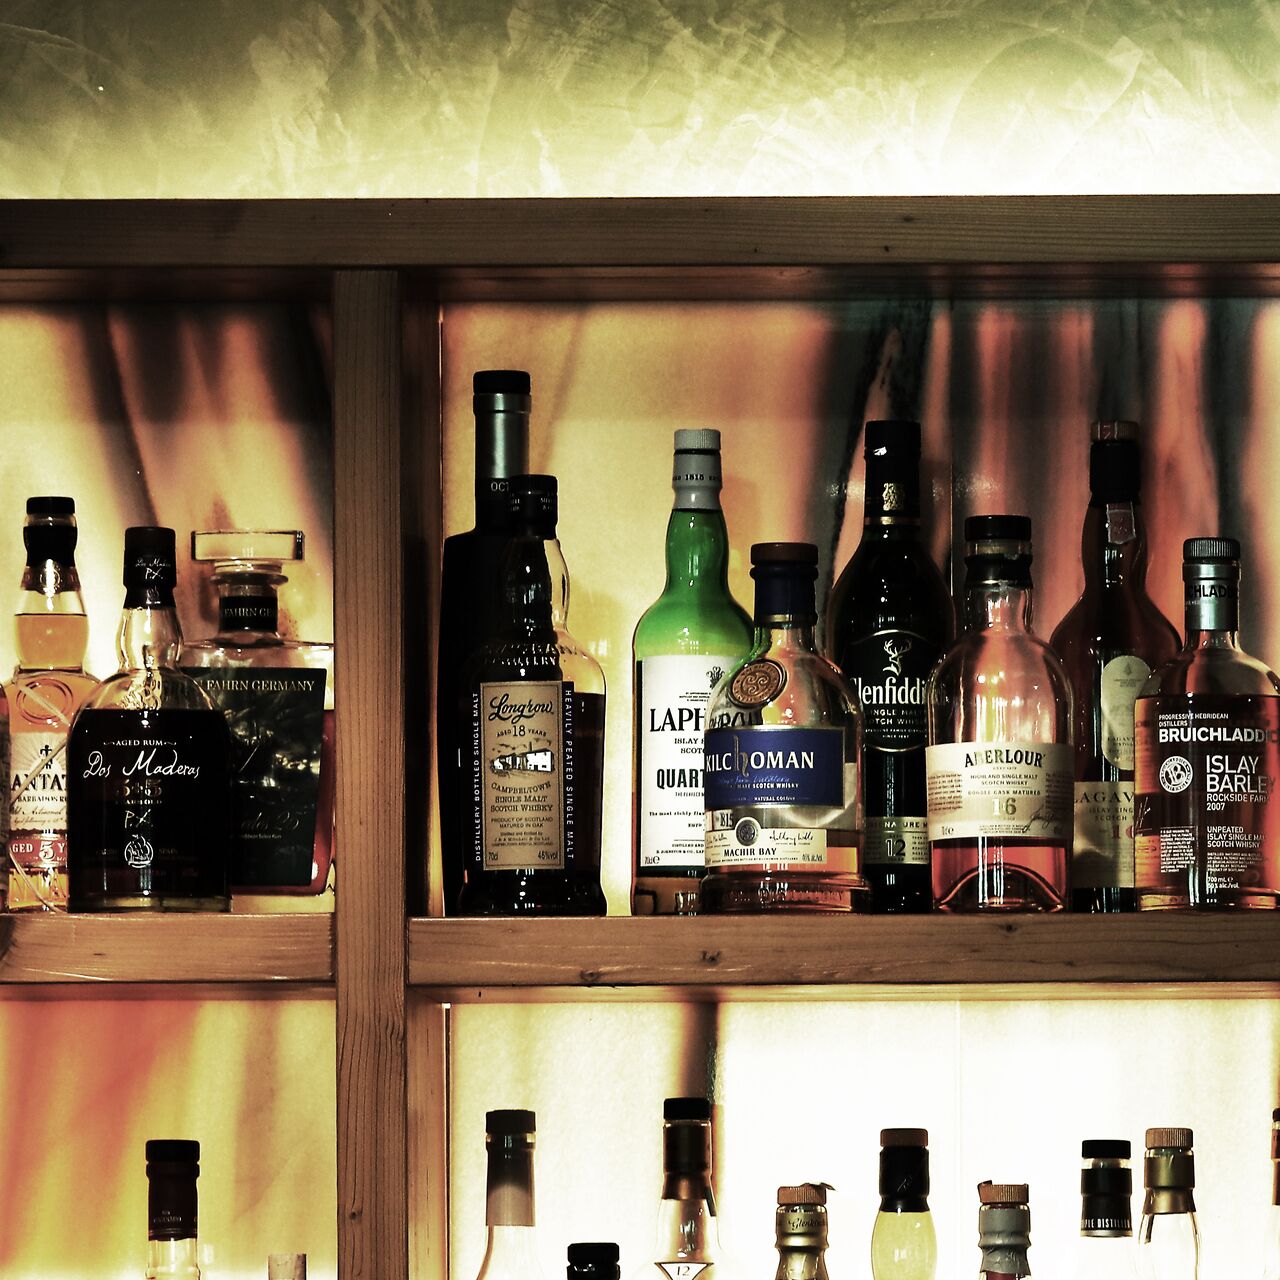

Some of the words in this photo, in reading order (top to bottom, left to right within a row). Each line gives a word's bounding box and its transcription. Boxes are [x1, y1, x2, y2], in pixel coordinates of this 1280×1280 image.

[252, 681, 314, 691] GERMANY
[488, 694, 554, 724] Longrow
[513, 725, 525, 736] 18
[528, 729, 547, 737] YEARS
[84, 751, 112, 778] Dos
[123, 749, 200, 778] Maderas
[965, 750, 1043, 768] ABERLOUR
[1207, 756, 1259, 773] ISLAY
[492, 782, 551, 794] CAMPBELTOWN
[1207, 774, 1275, 793] BARLEY
[495, 795, 522, 803] SINGLE
[525, 795, 547, 803] MALT
[1207, 794, 1248, 802] ROCKSIDE
[1207, 803, 1225, 811] 2007
[39, 840, 55, 861] 5
[759, 848, 776, 856] BAY
